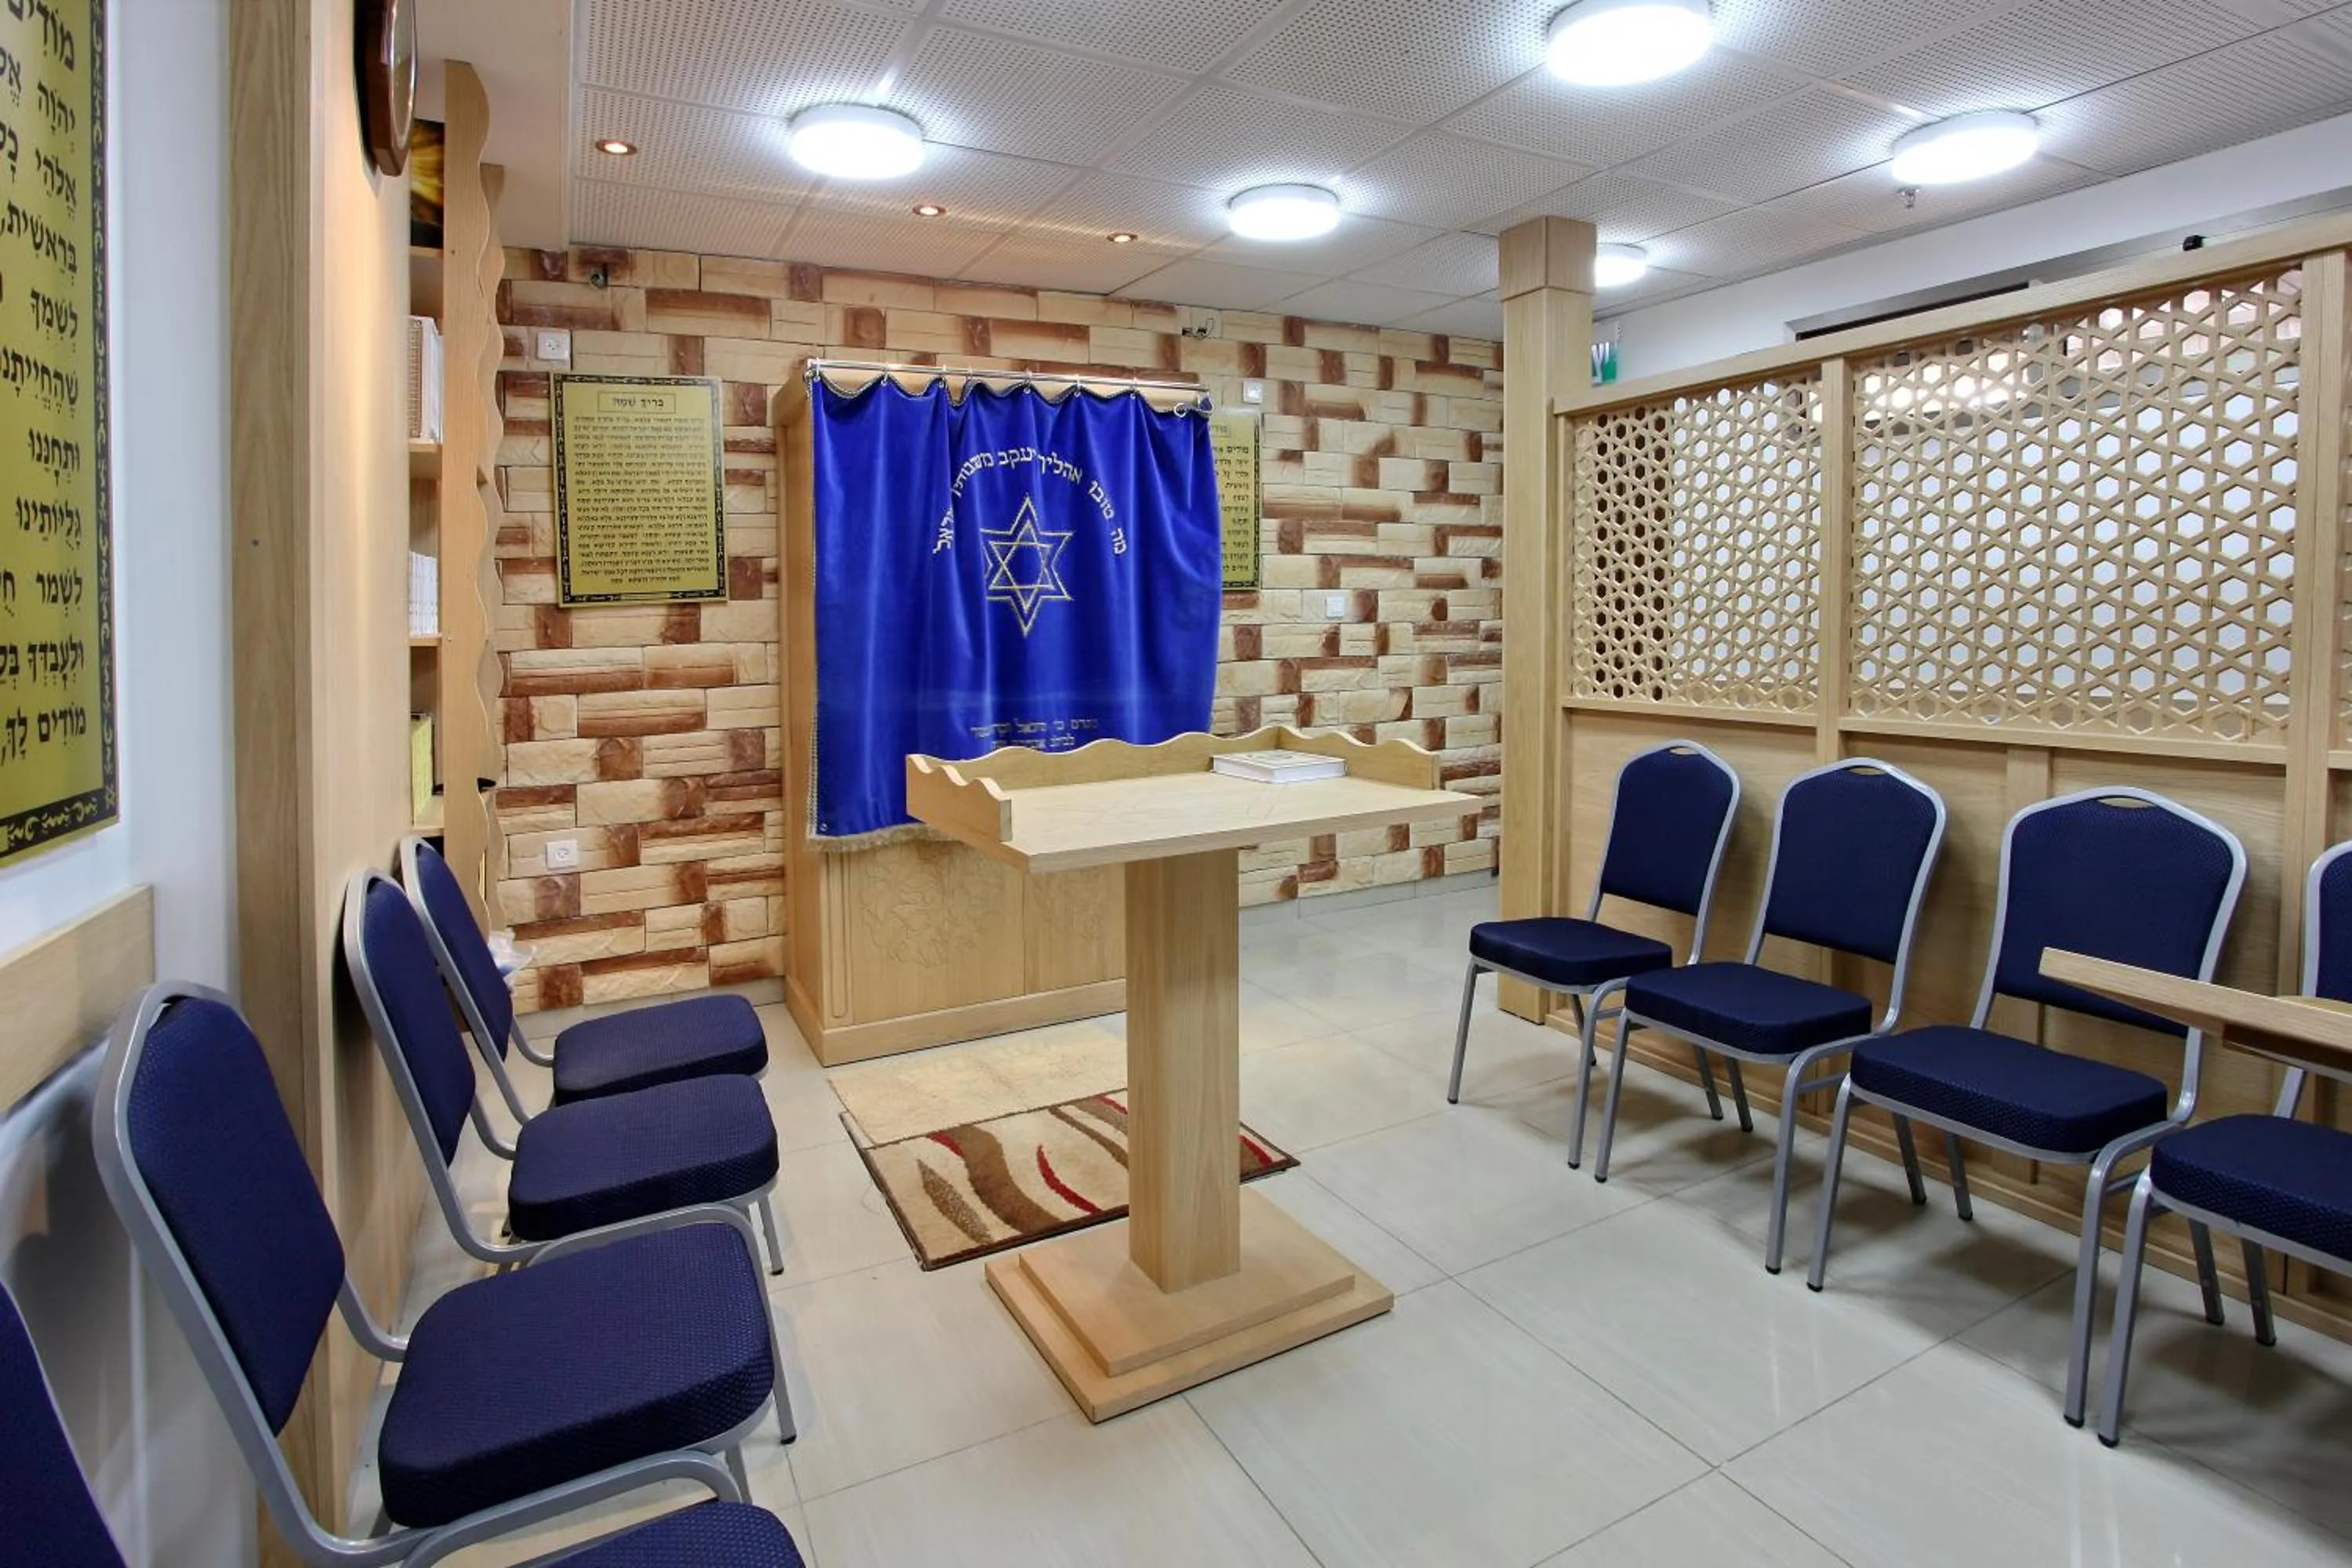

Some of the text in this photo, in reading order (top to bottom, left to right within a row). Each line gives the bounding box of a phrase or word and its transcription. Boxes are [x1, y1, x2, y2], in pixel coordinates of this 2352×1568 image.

[996, 446, 1037, 470] יעקב
[1037, 451, 1083, 485] אהליך
[1088, 481, 1115, 519] טובו
[1111, 527, 1127, 555] מה
